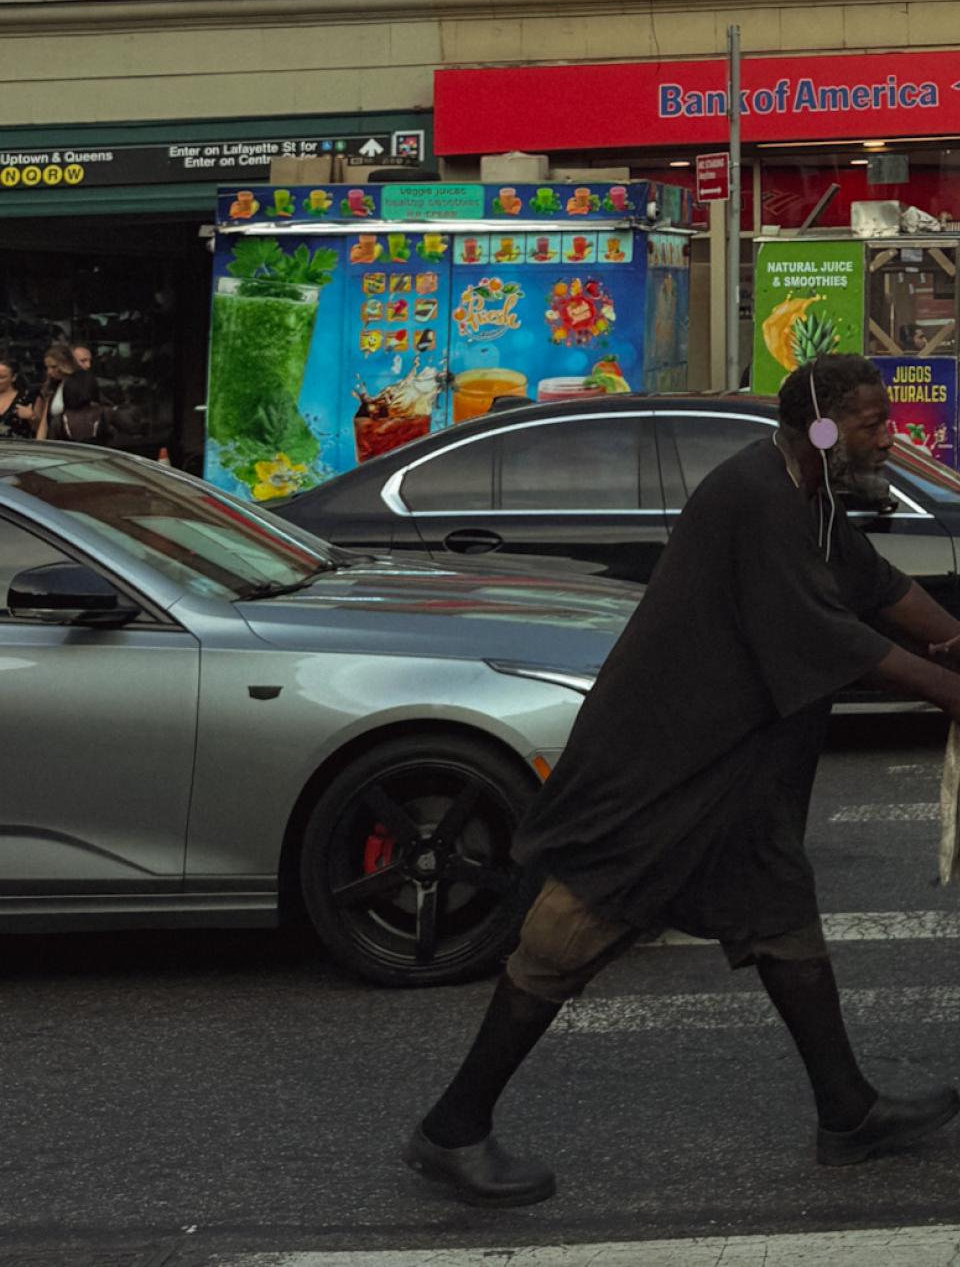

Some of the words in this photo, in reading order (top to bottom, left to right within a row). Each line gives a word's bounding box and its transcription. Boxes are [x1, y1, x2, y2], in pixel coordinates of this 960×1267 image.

[659, 83, 749, 118] Bank
[753, 78, 791, 114] of
[793, 74, 939, 113] America
[169, 145, 202, 157] Enter
[205, 146, 220, 156] on
[223, 141, 278, 156] Lafayette
[282, 141, 296, 152] St
[301, 141, 317, 152] for
[1, 153, 48, 165] Uptown
[52, 152, 61, 163] &
[64, 151, 113, 163] Queens
[184, 156, 217, 168] Enter
[220, 157, 235, 166] on
[238, 154, 272, 166] Centr
[67, 167, 81, 180] W
[767, 261, 818, 272] NATURAL
[821, 261, 854, 272] JUICE
[772, 276, 781, 287] &
[784, 275, 848, 287] SMOOTHIES
[893, 365, 932, 383] JUGOS
